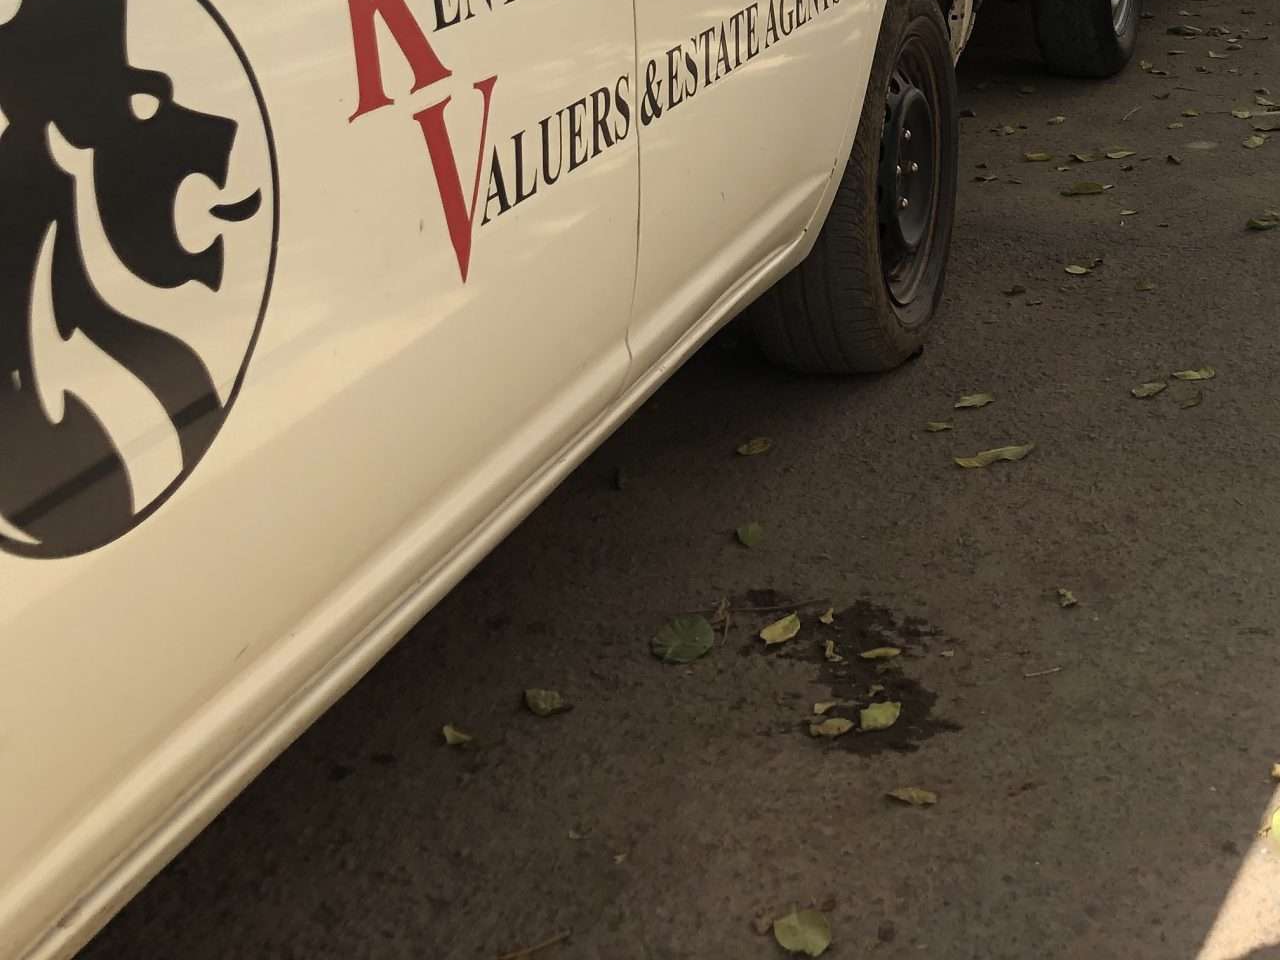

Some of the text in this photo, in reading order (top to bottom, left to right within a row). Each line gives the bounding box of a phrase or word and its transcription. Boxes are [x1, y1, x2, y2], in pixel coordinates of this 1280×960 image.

[413, 73, 632, 283] VALUERS
[640, 59, 663, 126] &
[666, 2, 760, 111] ESTATE
